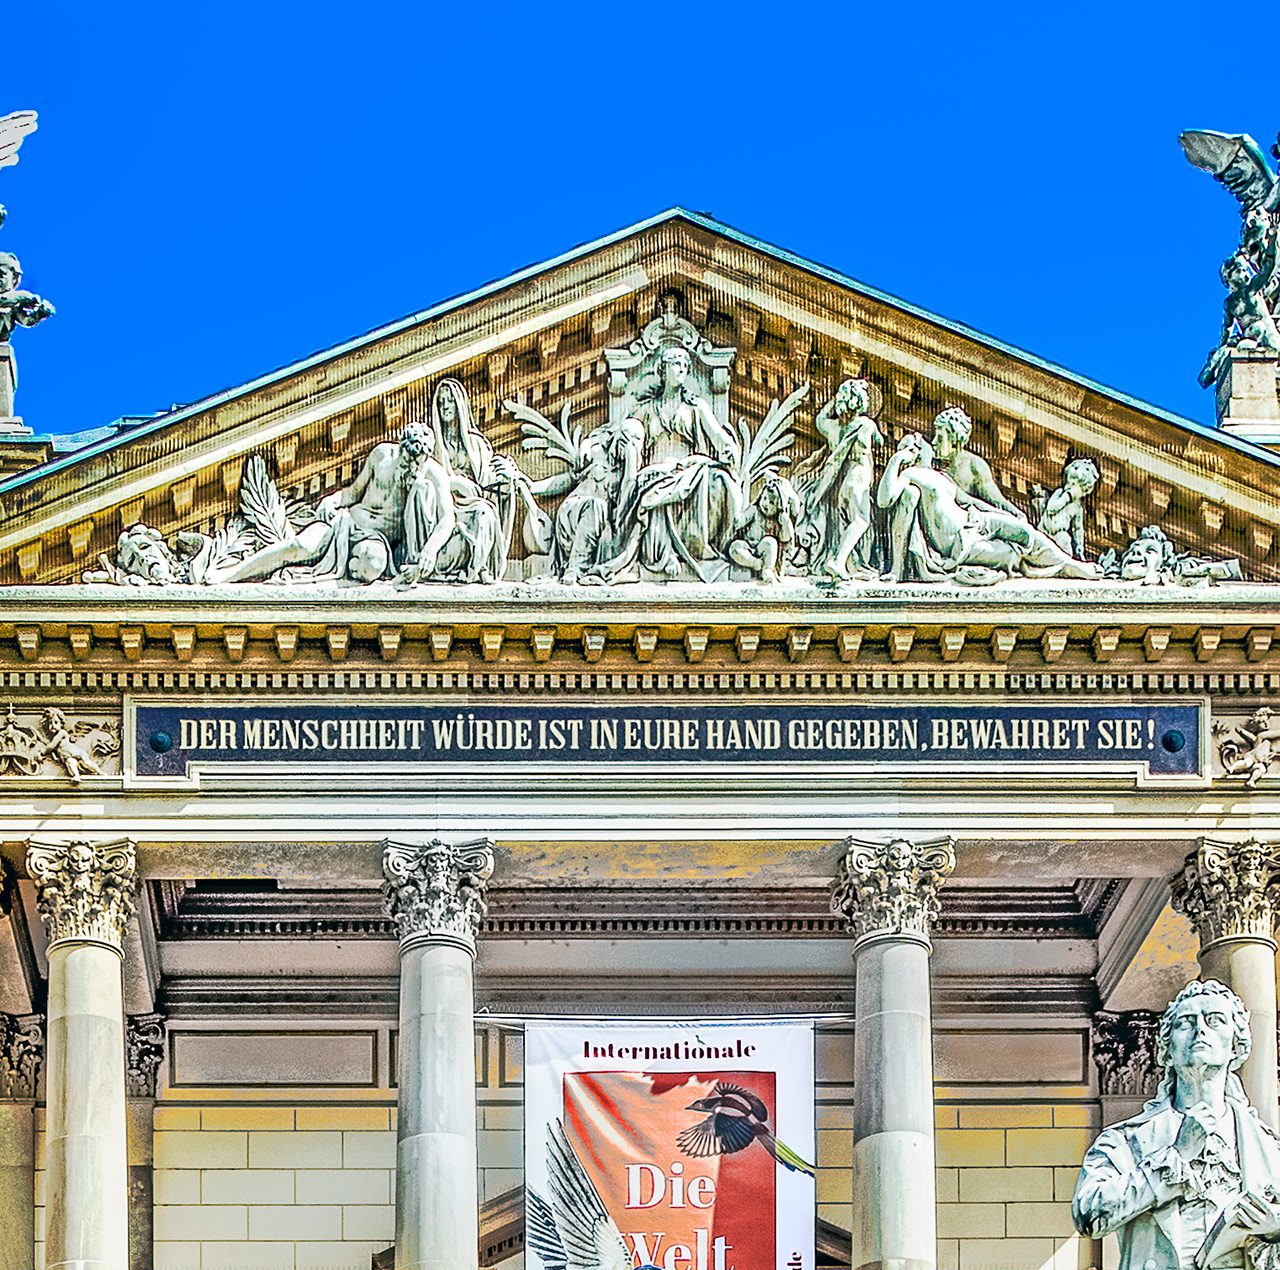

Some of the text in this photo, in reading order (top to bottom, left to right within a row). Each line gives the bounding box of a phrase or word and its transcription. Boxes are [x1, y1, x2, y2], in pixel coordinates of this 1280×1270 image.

[178, 713, 1155, 752] DER MENSCHHEIT WÜRDE IST IN EURE HAND GEGEBEN, BEWAHRET SIE!
[583, 1039, 757, 1060] Internationale
[624, 1161, 717, 1210] Die
